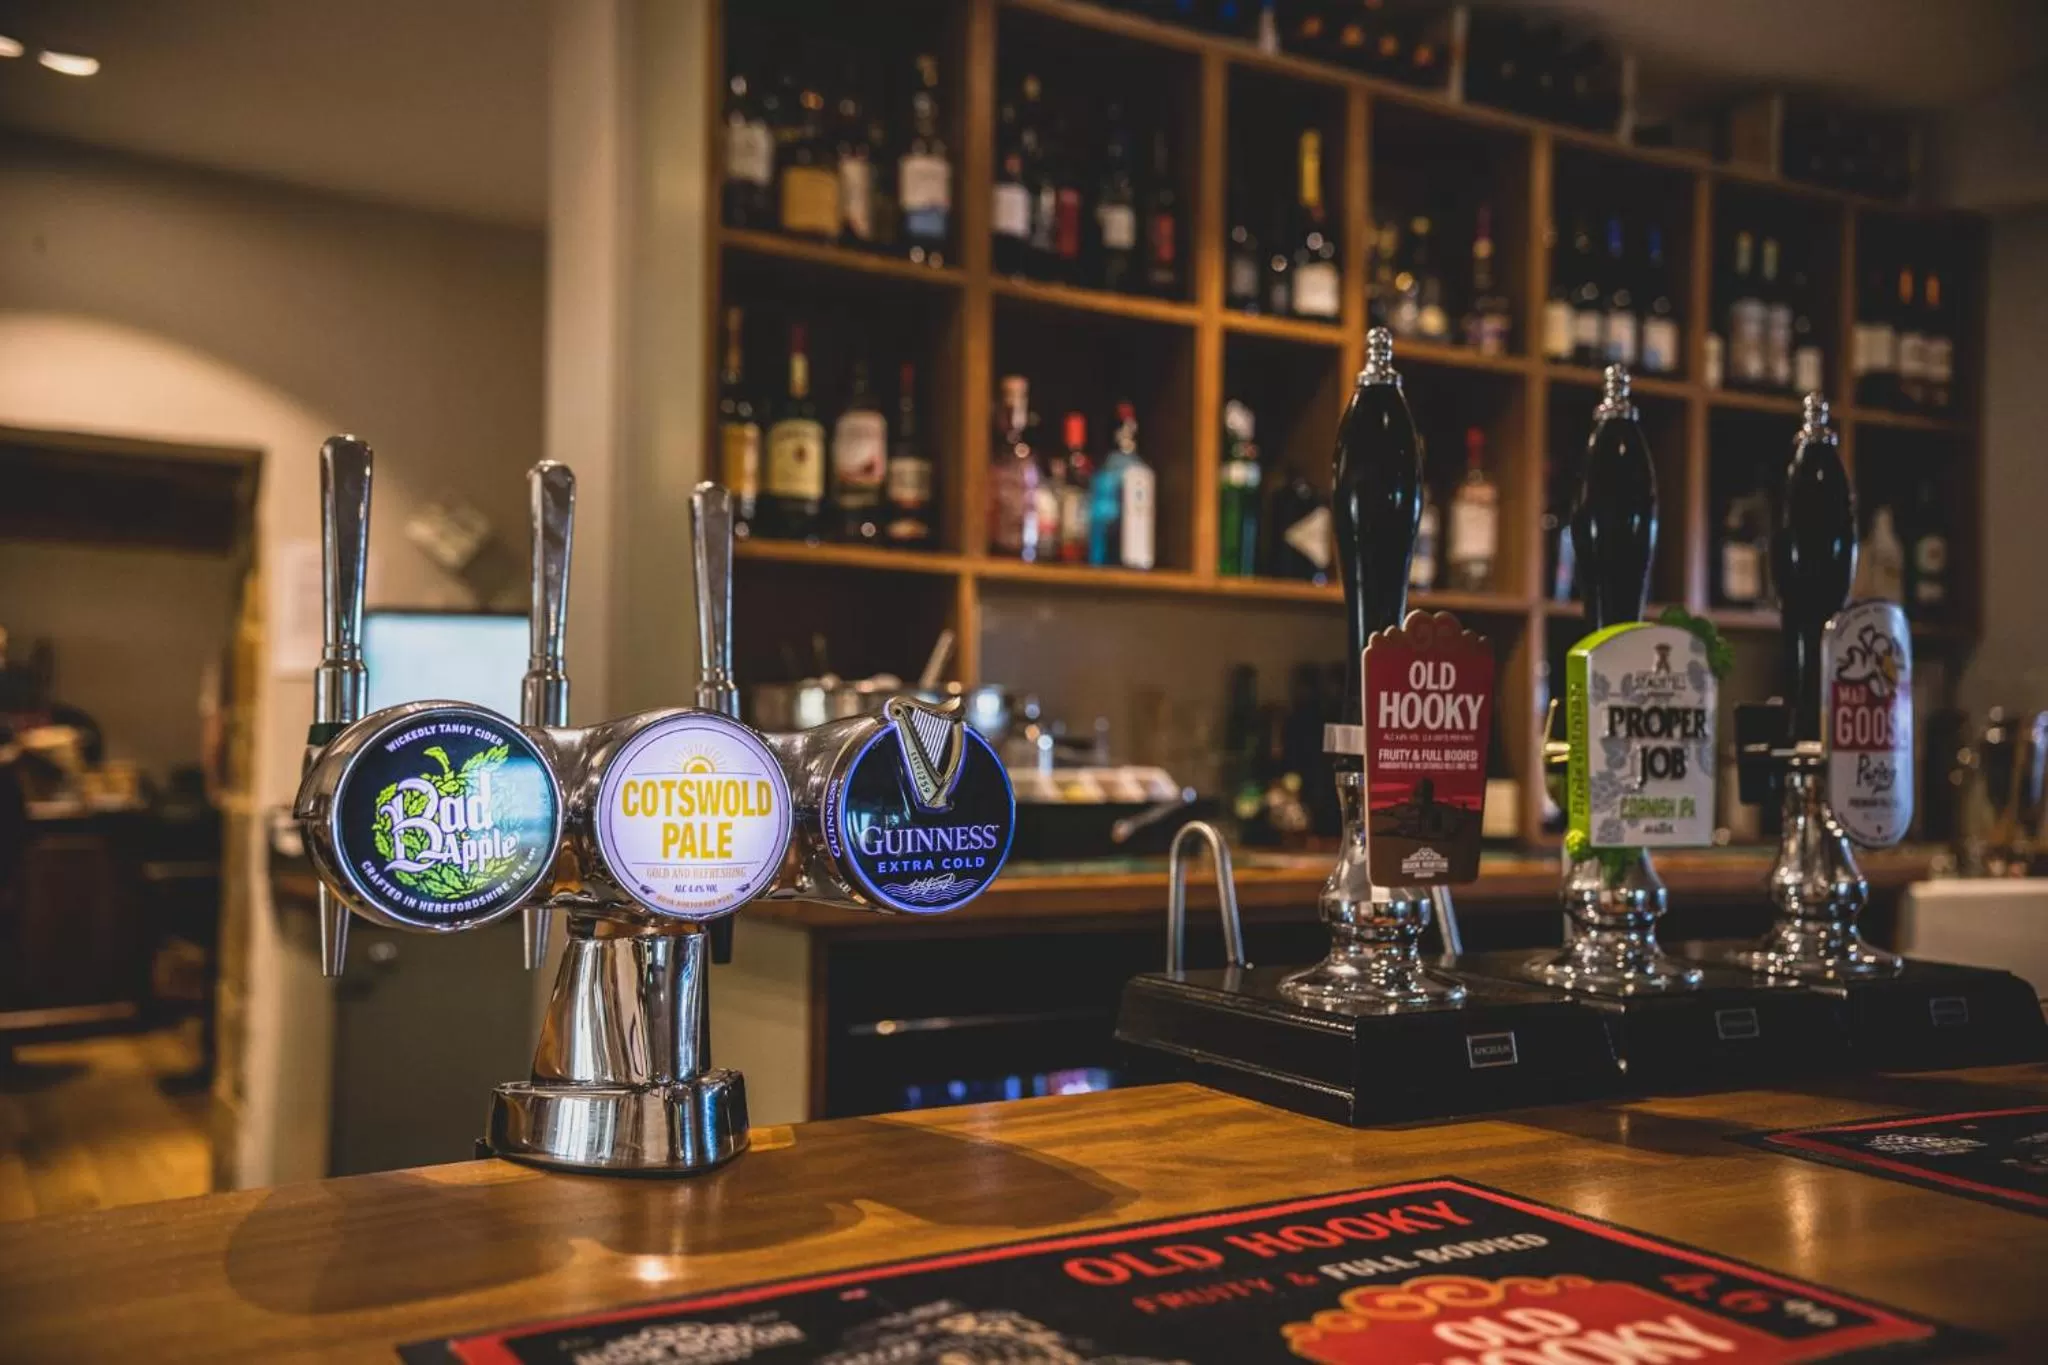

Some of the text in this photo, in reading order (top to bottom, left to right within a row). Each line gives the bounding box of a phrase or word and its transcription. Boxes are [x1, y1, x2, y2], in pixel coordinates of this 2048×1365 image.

[1409, 660, 1456, 690] OLD
[1378, 691, 1485, 730] HOOKY
[1606, 706, 1707, 738] PROPER
[385, 724, 504, 753] WICKEDLY TANGY CIDER
[1378, 748, 1479, 761] FRUITY & FULL BODIED
[1638, 745, 1687, 787] JOB
[622, 779, 772, 817] COTSWOLD
[380, 768, 494, 872] Bad
[827, 779, 842, 858] GUINNESS
[442, 830, 520, 873] Apple
[661, 821, 733, 860] PALE
[859, 825, 998, 856] GUINNESS
[877, 857, 985, 874] EXTRA COLD
[361, 860, 404, 903] CRAFTED
[404, 896, 417, 909] IN
[419, 881, 511, 913] HEREFORDSHIRE
[1063, 1199, 1473, 1286] OLD HOOKY
[1132, 1276, 1275, 1315] FRUITY
[1318, 1254, 1422, 1282] FULL
[1414, 1232, 1550, 1265] BODIED
[1432, 1306, 1583, 1351] OLD
